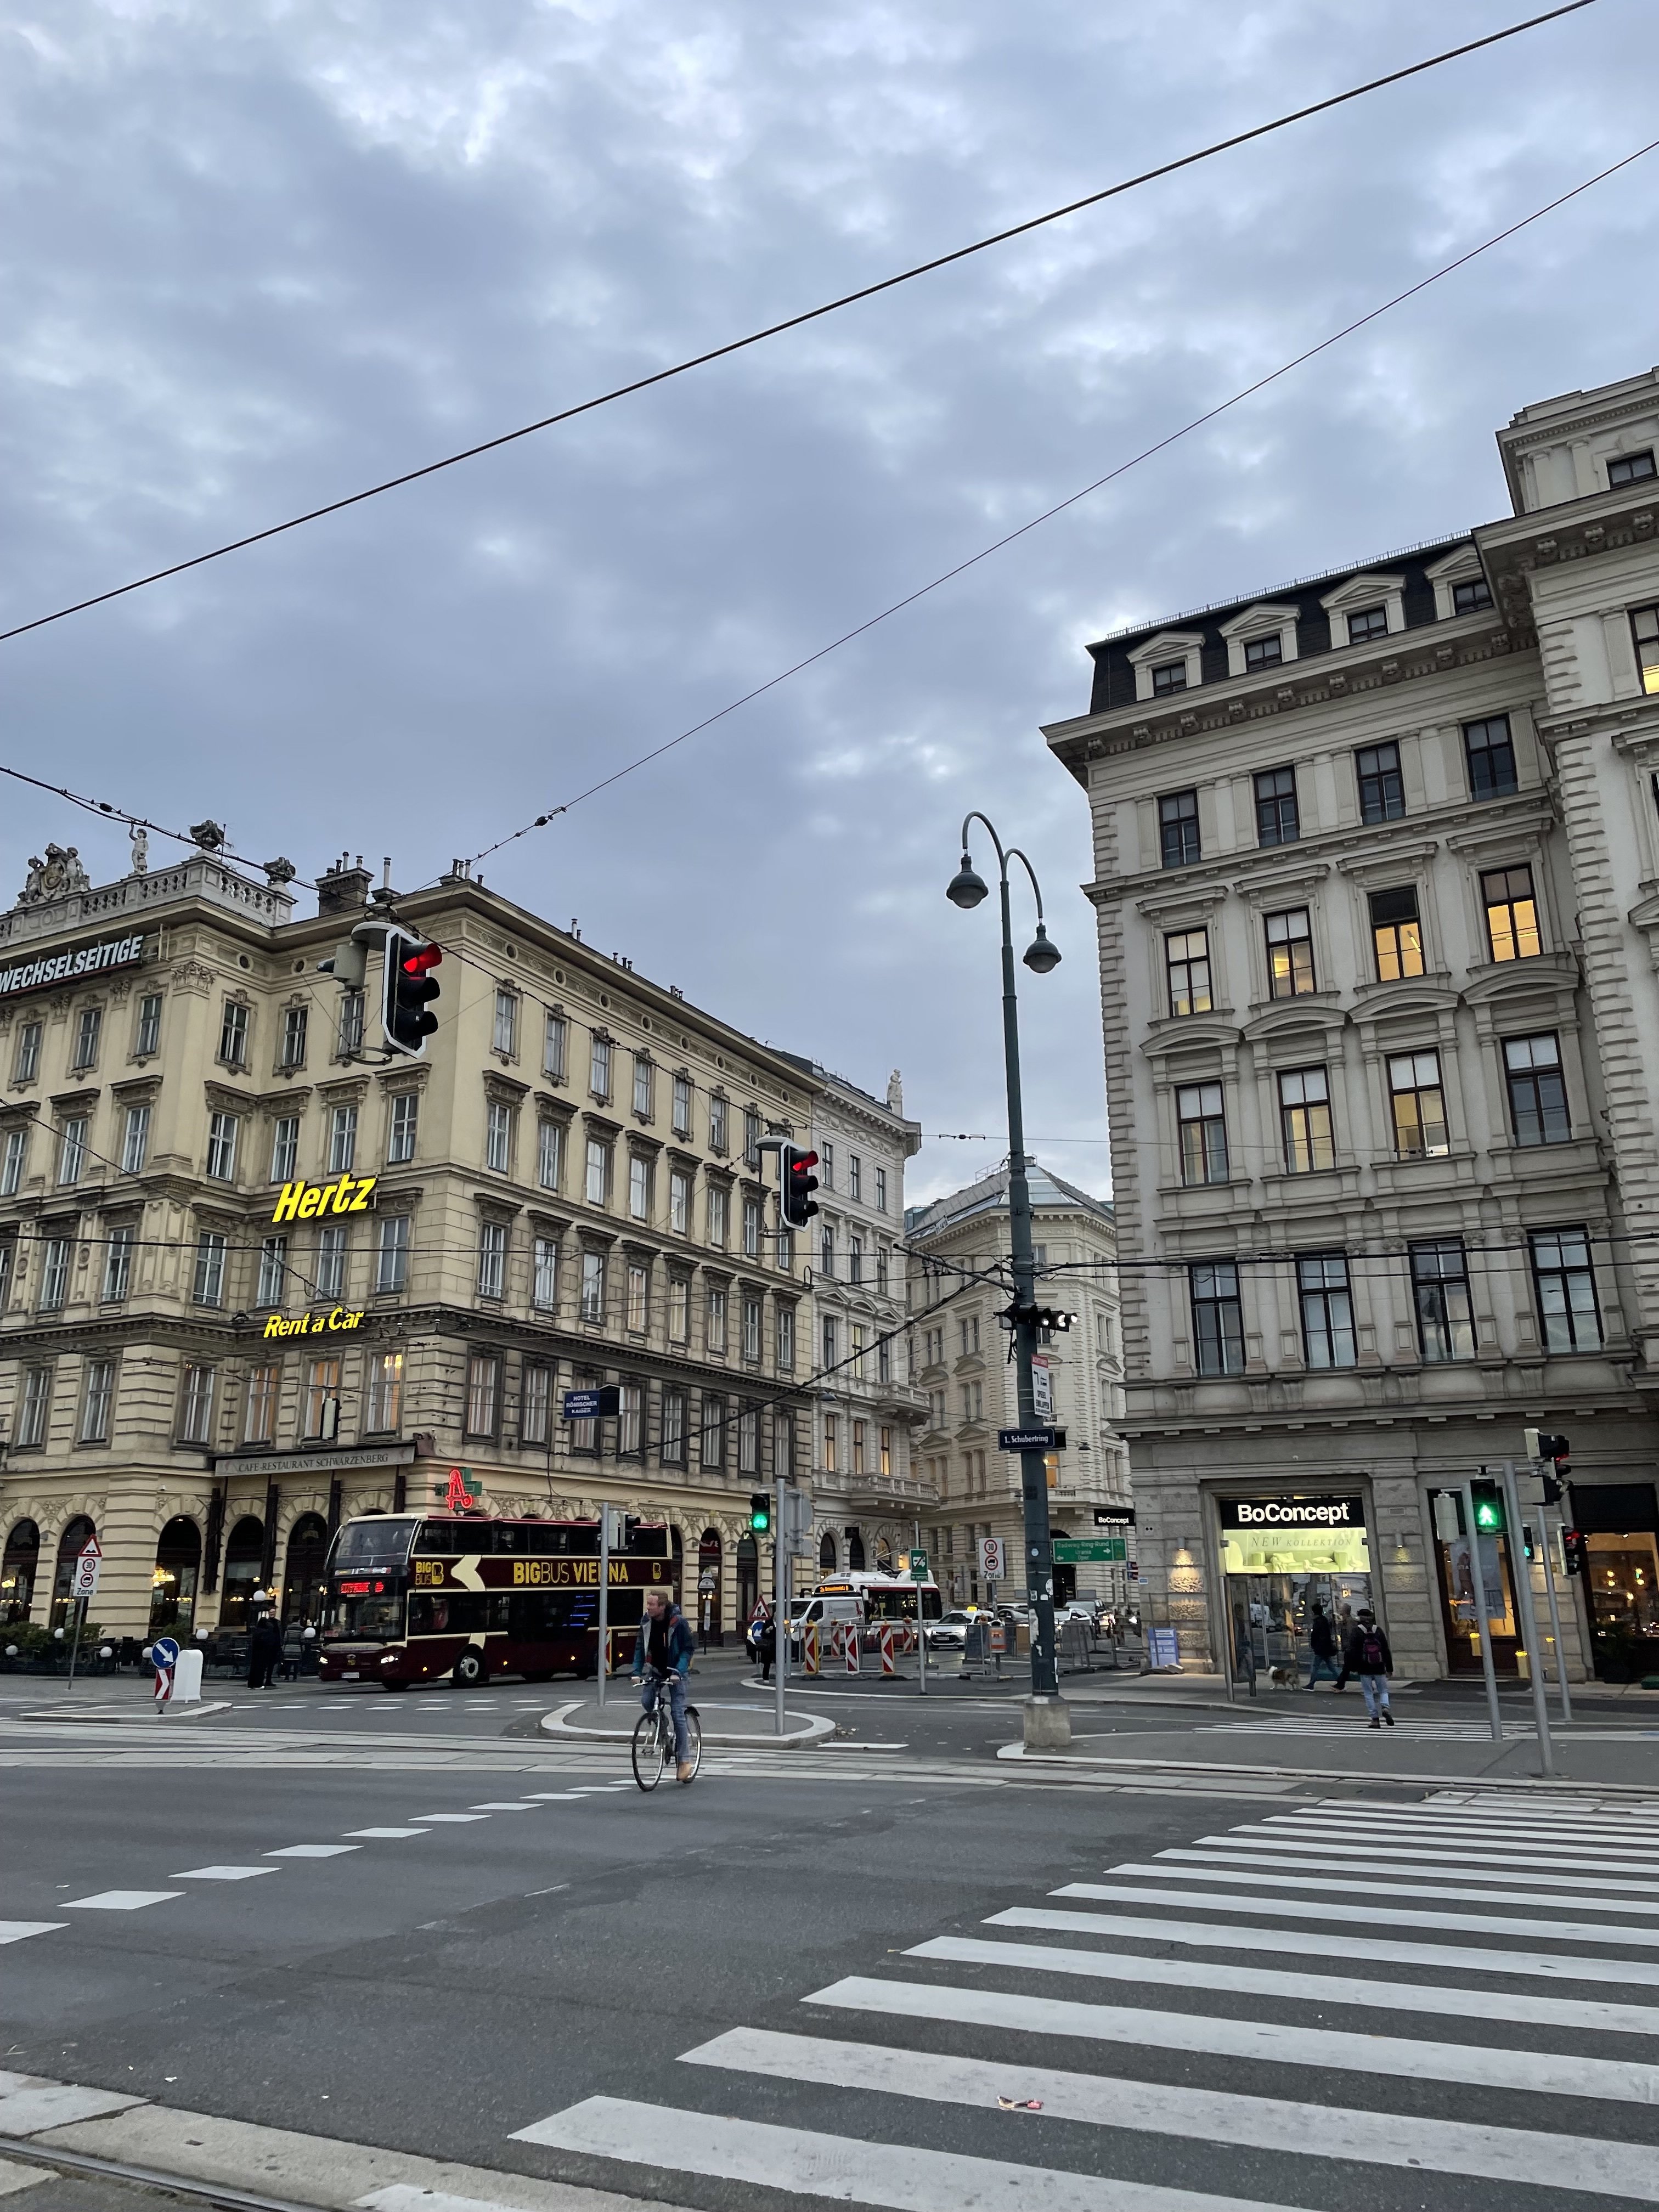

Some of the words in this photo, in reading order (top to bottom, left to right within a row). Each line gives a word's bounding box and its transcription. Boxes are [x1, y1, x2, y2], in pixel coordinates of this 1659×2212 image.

[0, 935, 144, 993] WECHSELSEITIGE
[272, 1173, 376, 1222] Hertz
[263, 1313, 310, 1338] Rent
[312, 1317, 325, 1332] a
[329, 1307, 364, 1330] Car
[1011, 1435, 1048, 1443] Schubertring
[316, 1454, 388, 1466] SCHWARZENBERG
[1238, 1503, 1350, 1525] BoConcept
[1251, 1537, 1282, 1547] NEW
[1286, 1538, 1352, 1547] KOLLEKTION
[416, 1562, 431, 1573] BIG
[415, 1574, 431, 1585] BUS
